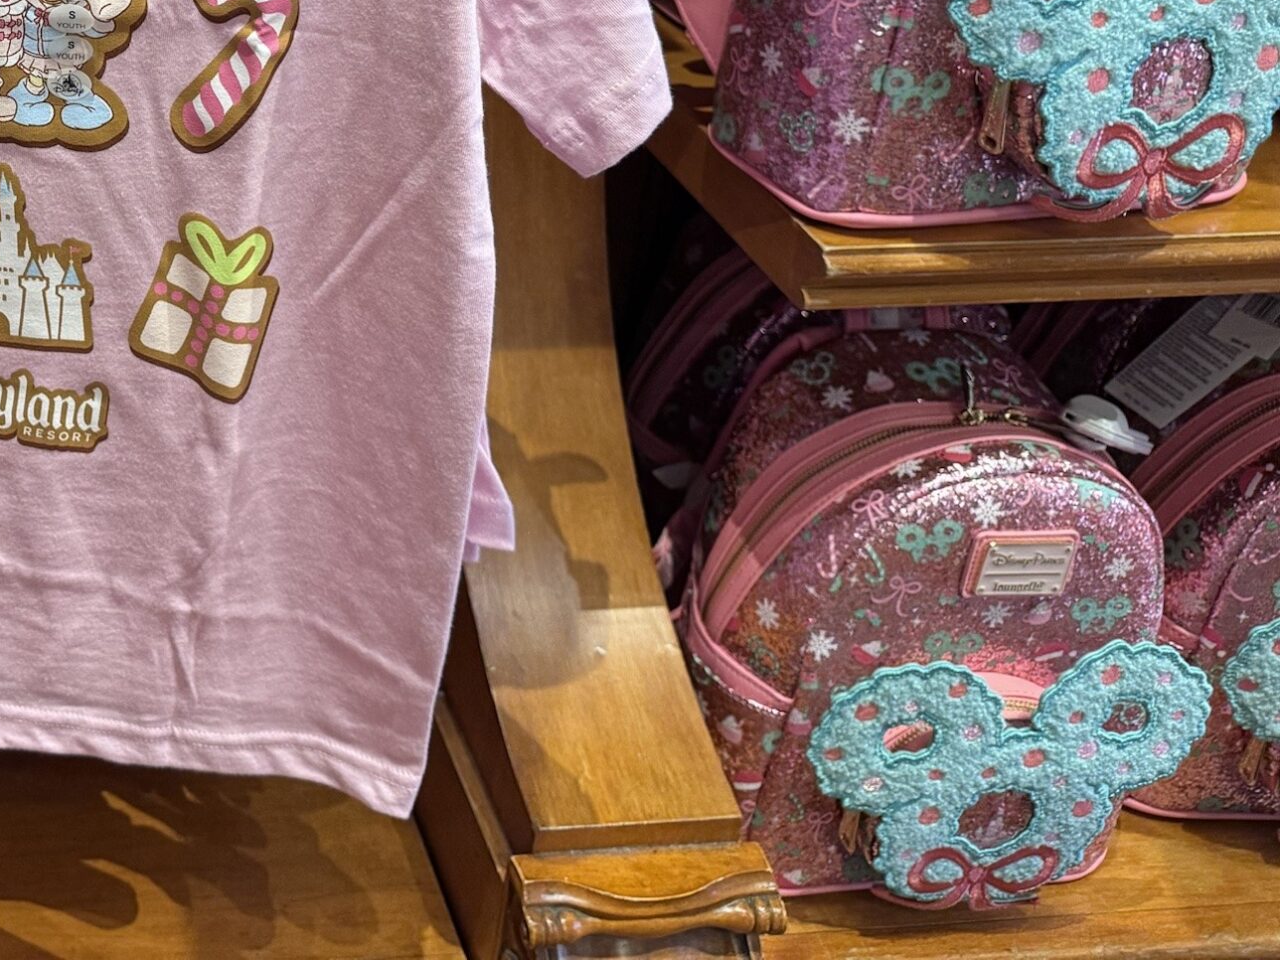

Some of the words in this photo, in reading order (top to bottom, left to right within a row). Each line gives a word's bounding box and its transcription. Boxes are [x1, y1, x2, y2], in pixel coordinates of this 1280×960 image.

[68, 10, 76, 19] S
[67, 41, 75, 49] S
[56, 52, 85, 60] YOUTH
[23, 426, 93, 442] RESORT
